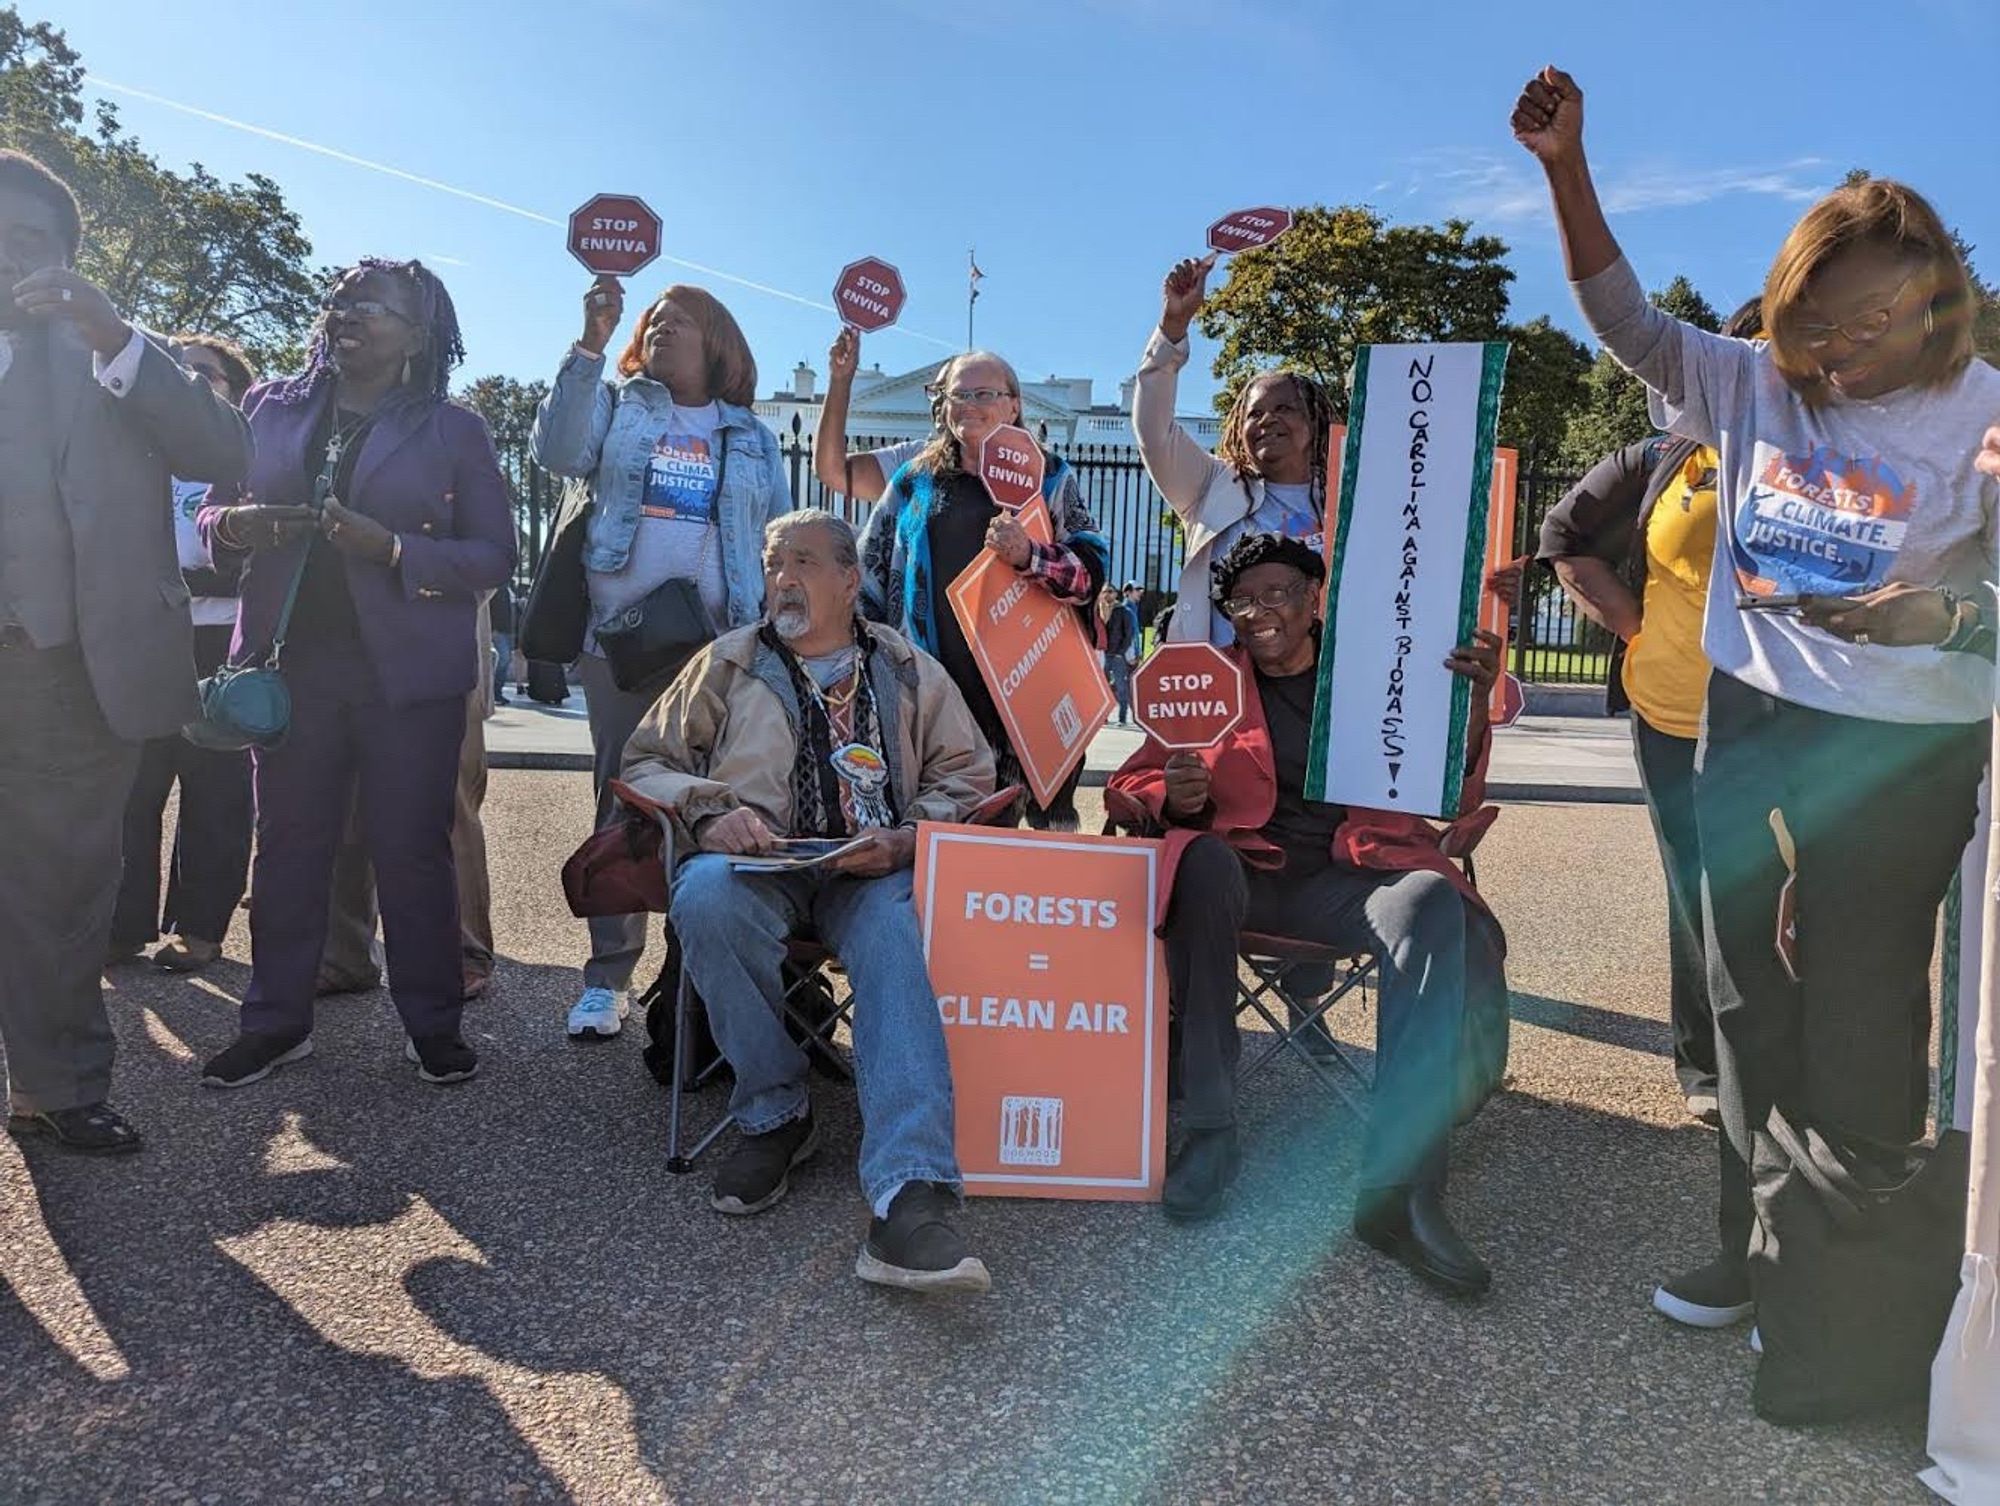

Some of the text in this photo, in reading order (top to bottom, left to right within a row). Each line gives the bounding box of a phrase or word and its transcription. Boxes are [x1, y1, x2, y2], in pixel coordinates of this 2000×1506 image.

[591, 217, 639, 232] STOP
[1239, 215, 1275, 228] STOP
[580, 237, 648, 253] ENVIVA
[1217, 224, 1265, 243] ENVIVA
[856, 276, 890, 297] STOP
[842, 288, 889, 318] ENVIVA
[997, 446, 1030, 465] STOP
[667, 460, 711, 477] CLIMA
[988, 464, 1033, 489] ENVIVA
[1402, 410, 1430, 531] CAROLINA
[649, 471, 708, 492] JUSTICE.
[1773, 466, 1873, 515] FORESTS.
[1780, 500, 1888, 546] CLIMATE.
[1744, 519, 1844, 564] JUSTICE.
[1394, 535, 1421, 630] AGAINST
[989, 579, 1030, 626] FORES
[1002, 605, 1070, 698] COMMUNITY
[1159, 674, 1214, 692] STOP
[1147, 700, 1228, 719] ENVIVA
[965, 891, 1118, 929] FORESTS
[1028, 953, 1049, 970] =
[937, 995, 1129, 1034] CLEAN AIR
